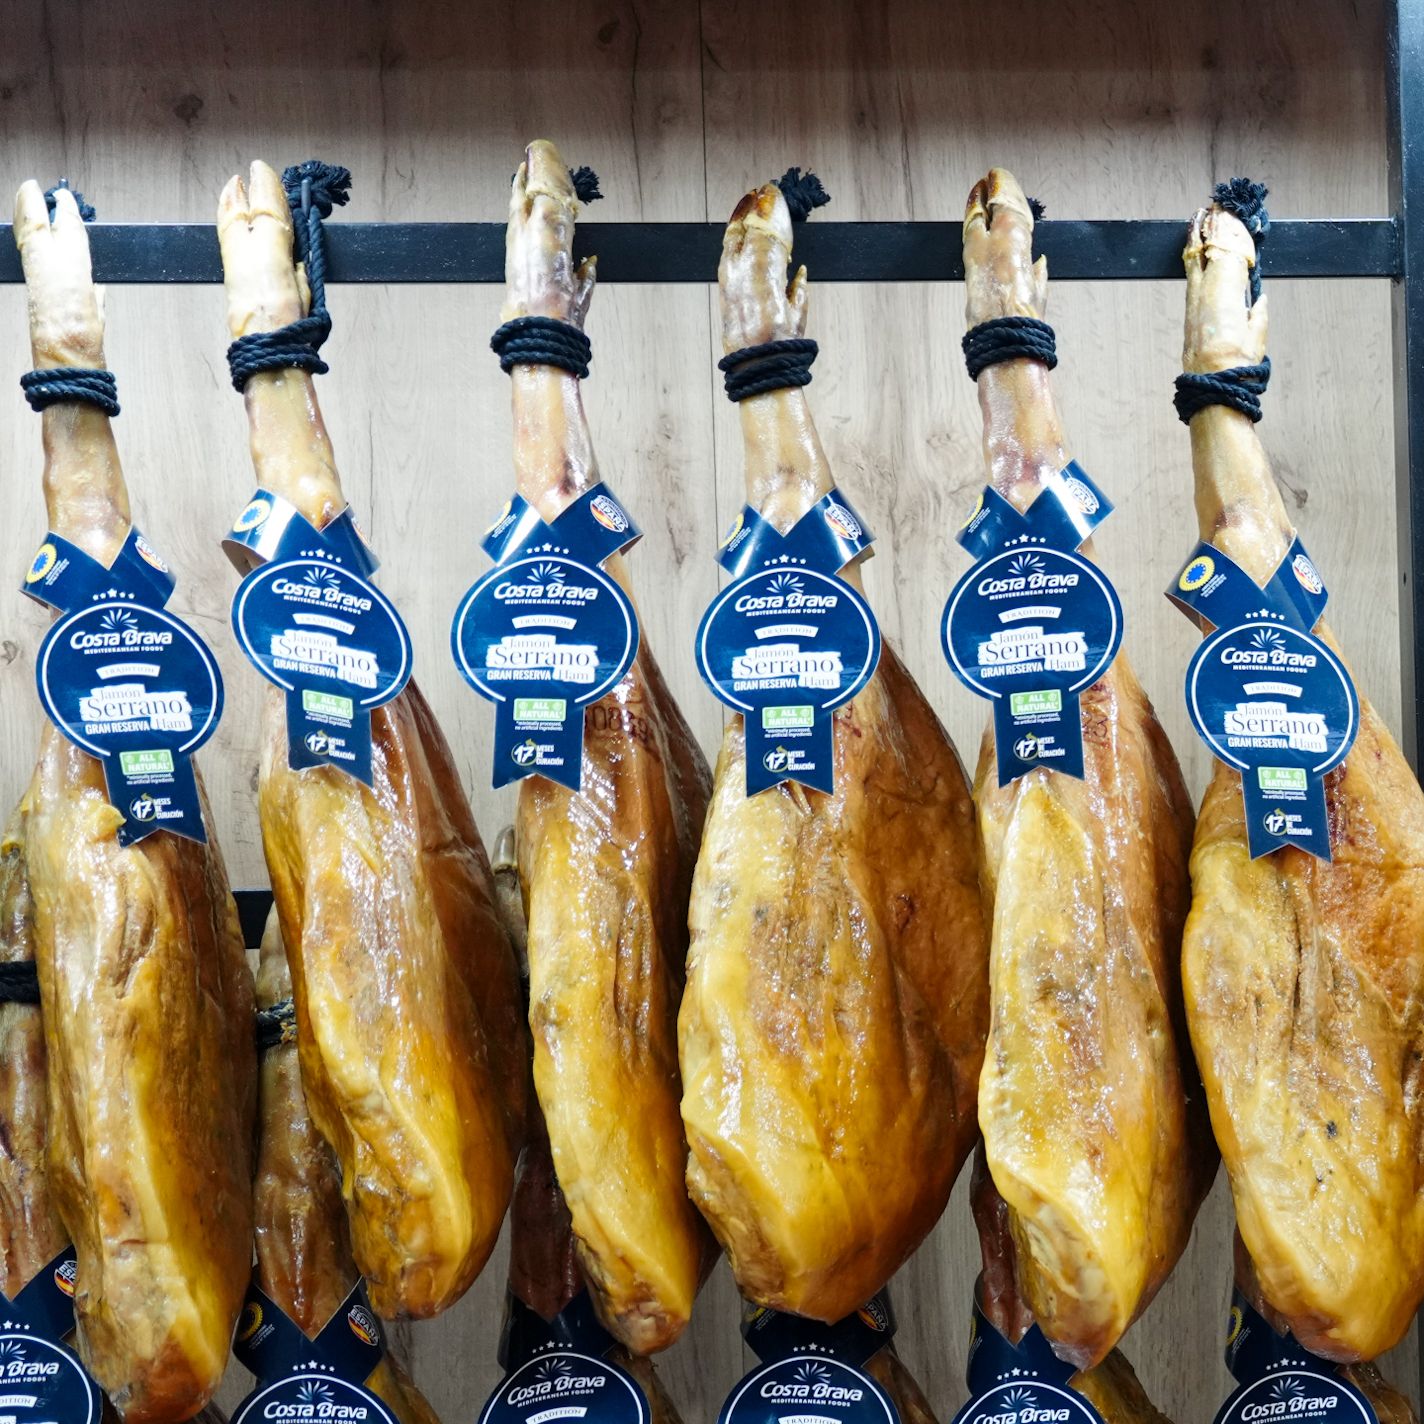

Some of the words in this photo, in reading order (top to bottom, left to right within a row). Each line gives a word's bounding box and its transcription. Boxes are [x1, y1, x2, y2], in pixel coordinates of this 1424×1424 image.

[494, 581, 544, 599] Costa
[545, 582, 599, 601] Brava
[978, 576, 1025, 596] Costa
[1026, 573, 1079, 589] Brava
[735, 594, 784, 612] Costa
[785, 592, 838, 608] Brava
[71, 631, 120, 650] Costa
[121, 629, 174, 646] Brava
[495, 646, 590, 667] Serrano
[985, 638, 1080, 663] Serrano
[1222, 647, 1267, 665] Costa
[1268, 649, 1317, 669] Brava
[739, 657, 835, 677] Serrano
[1285, 666, 1308, 674] FOODS
[1249, 684, 1297, 694] TRADITION
[86, 698, 185, 720] Serrano
[1244, 705, 1282, 716] Jamón
[1231, 713, 1321, 735] Serrano
[1228, 738, 1253, 749] GRAN
[1252, 738, 1288, 748] RESERVA
[1293, 737, 1322, 749] Ham
[1274, 770, 1291, 779] ALL
[1264, 815, 1285, 833] 17
[1285, 814, 1303, 822] MESES
[1287, 827, 1313, 835] CURACIÓN
[505, 1381, 552, 1404] Costa
[553, 1374, 606, 1392] Brava
[761, 1380, 810, 1398] Costa
[811, 1383, 864, 1403] Brava
[264, 1400, 314, 1419] Costa
[315, 1402, 368, 1421] Brava
[1018, 1407, 1070, 1424] Brava
